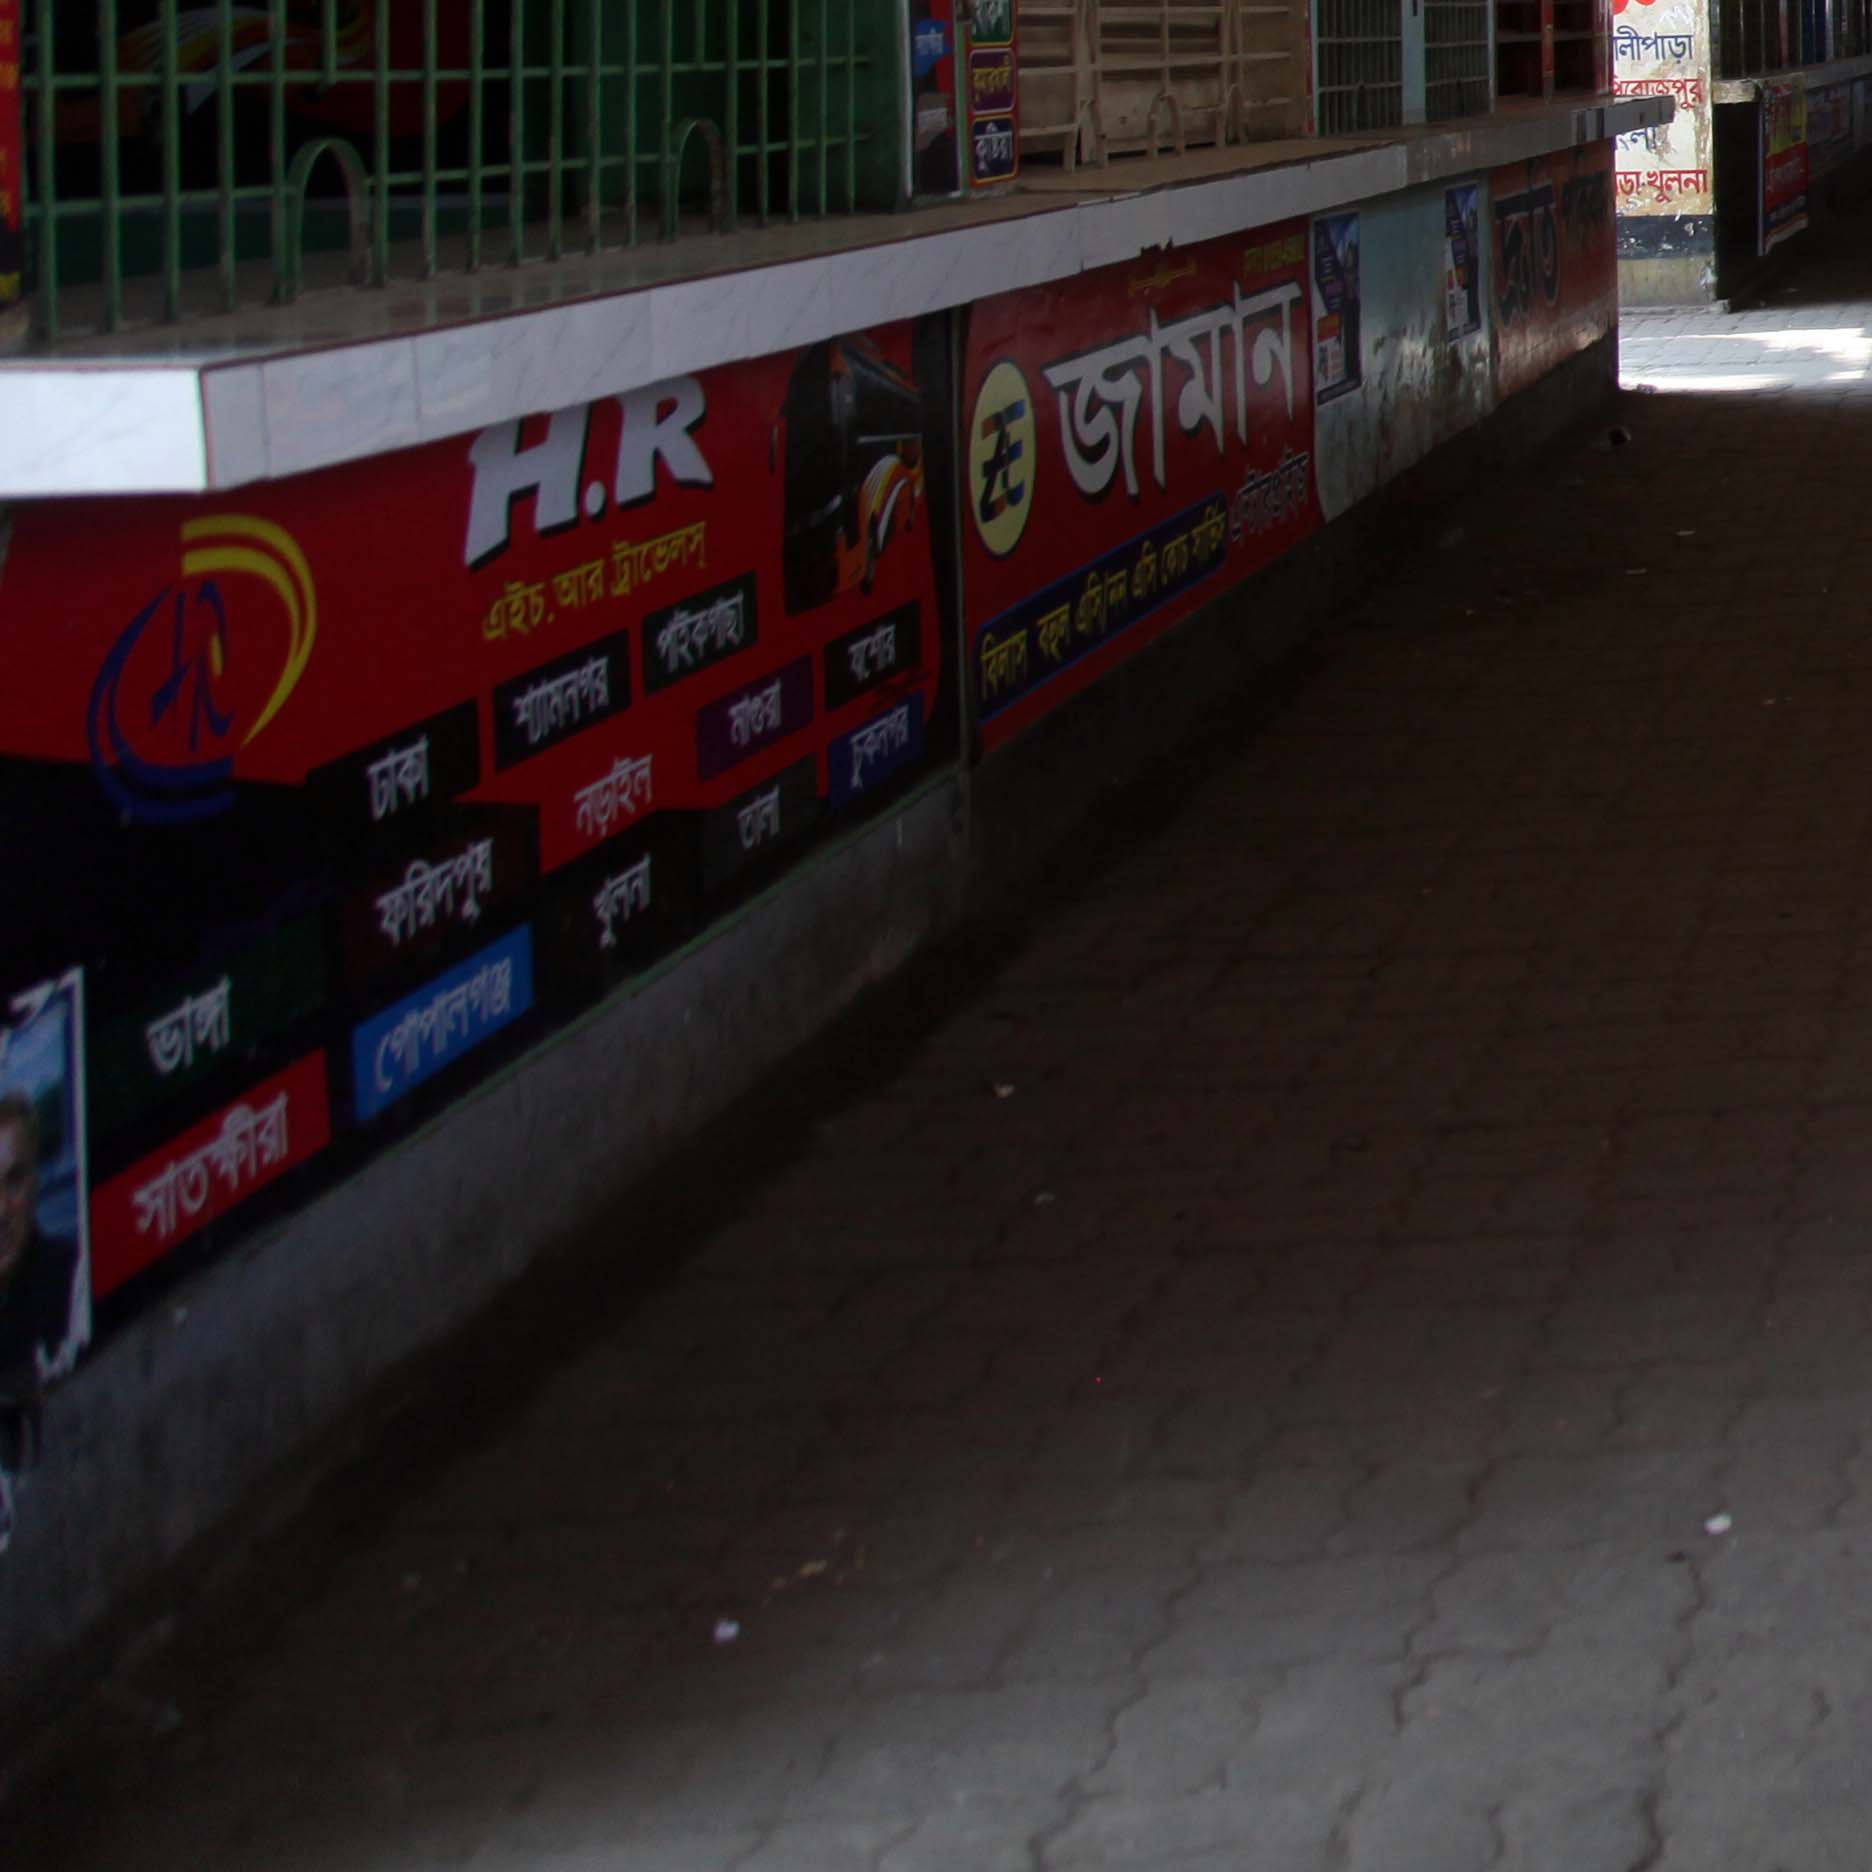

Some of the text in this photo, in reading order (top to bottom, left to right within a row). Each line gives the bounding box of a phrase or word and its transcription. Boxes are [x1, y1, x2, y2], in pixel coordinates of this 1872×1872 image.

[1045, 281, 1300, 497] জামান
[464, 372, 713, 570] H.R
[849, 624, 896, 682] যশোর
[728, 677, 782, 749] মাগুরা
[367, 738, 430, 821] ঢাকা
[575, 755, 653, 836] নড়াইল
[737, 786, 780, 849] তালা
[376, 836, 492, 944] ফরিদপুর
[593, 855, 651, 946] খুলনা
[146, 976, 230, 1077] ভাঙ্গা
[375, 952, 513, 1094] গোপালগঞ্জ
[133, 1090, 290, 1240] সাতক্ষীরা
